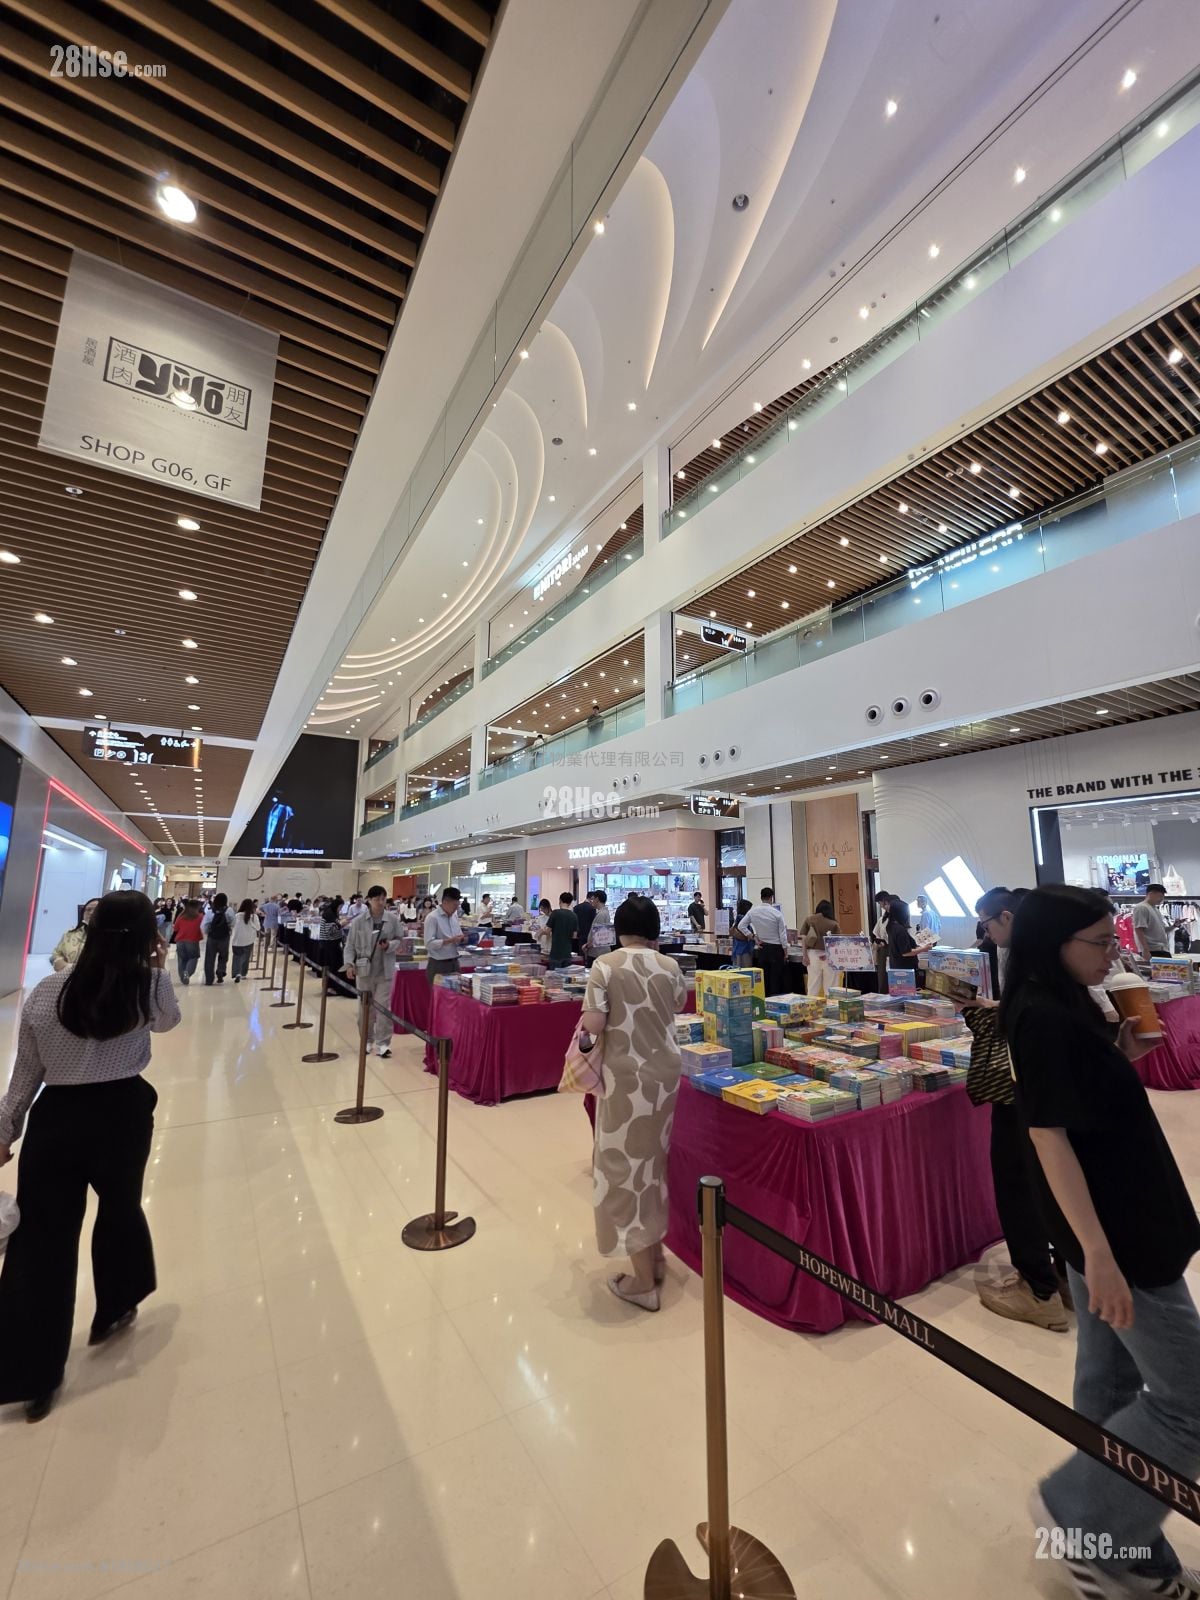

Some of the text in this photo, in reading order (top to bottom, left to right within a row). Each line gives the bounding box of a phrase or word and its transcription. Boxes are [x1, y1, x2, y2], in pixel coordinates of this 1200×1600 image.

[111, 343, 136, 386] 酒肉
[223, 385, 247, 426] 朋友
[79, 435, 233, 492] SHOP G06, GF
[1026, 786, 1053, 800] THE
[1056, 780, 1106, 796] BRAND
[1111, 773, 1154, 789] WITH
[1157, 769, 1193, 784] THE
[568, 842, 626, 859] TOKYO LIFESTYLE
[798, 1250, 937, 1350] HOPEWELL MALL
